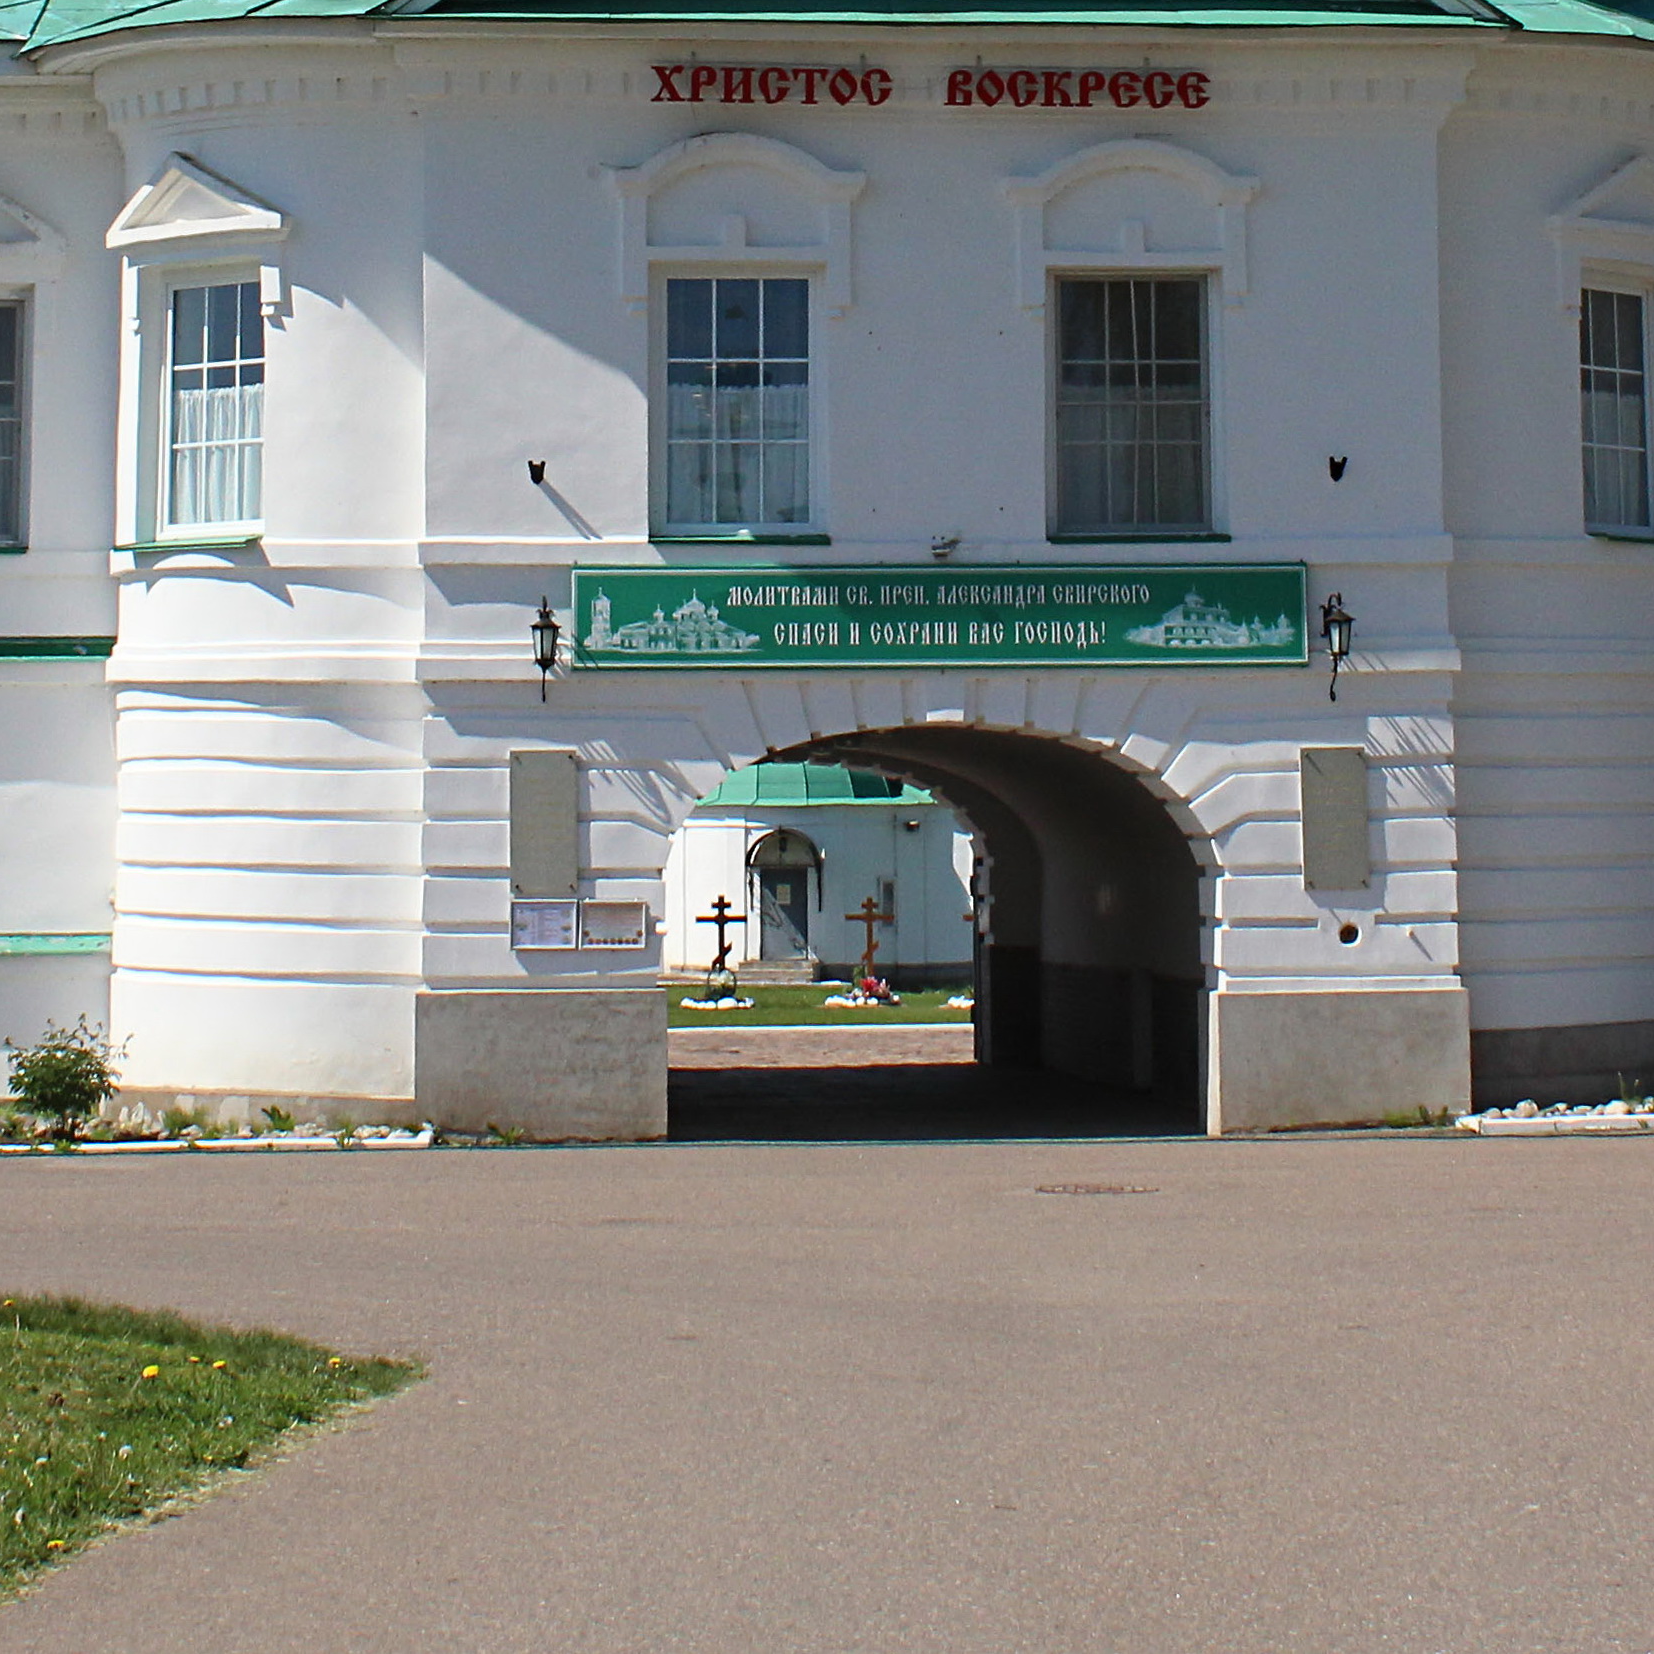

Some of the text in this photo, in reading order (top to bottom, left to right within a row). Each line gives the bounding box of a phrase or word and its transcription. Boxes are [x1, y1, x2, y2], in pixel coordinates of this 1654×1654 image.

[650, 64, 893, 106] ХРИСТОС
[726, 583, 1150, 610] МОЛИТВАМИ СВ. ПРЕП. АЛЕКСАНДРА СВИРСКОГО
[773, 620, 1107, 650] СПАСИ И СОХРАНИ ВАС ГОСПОДЬ!
